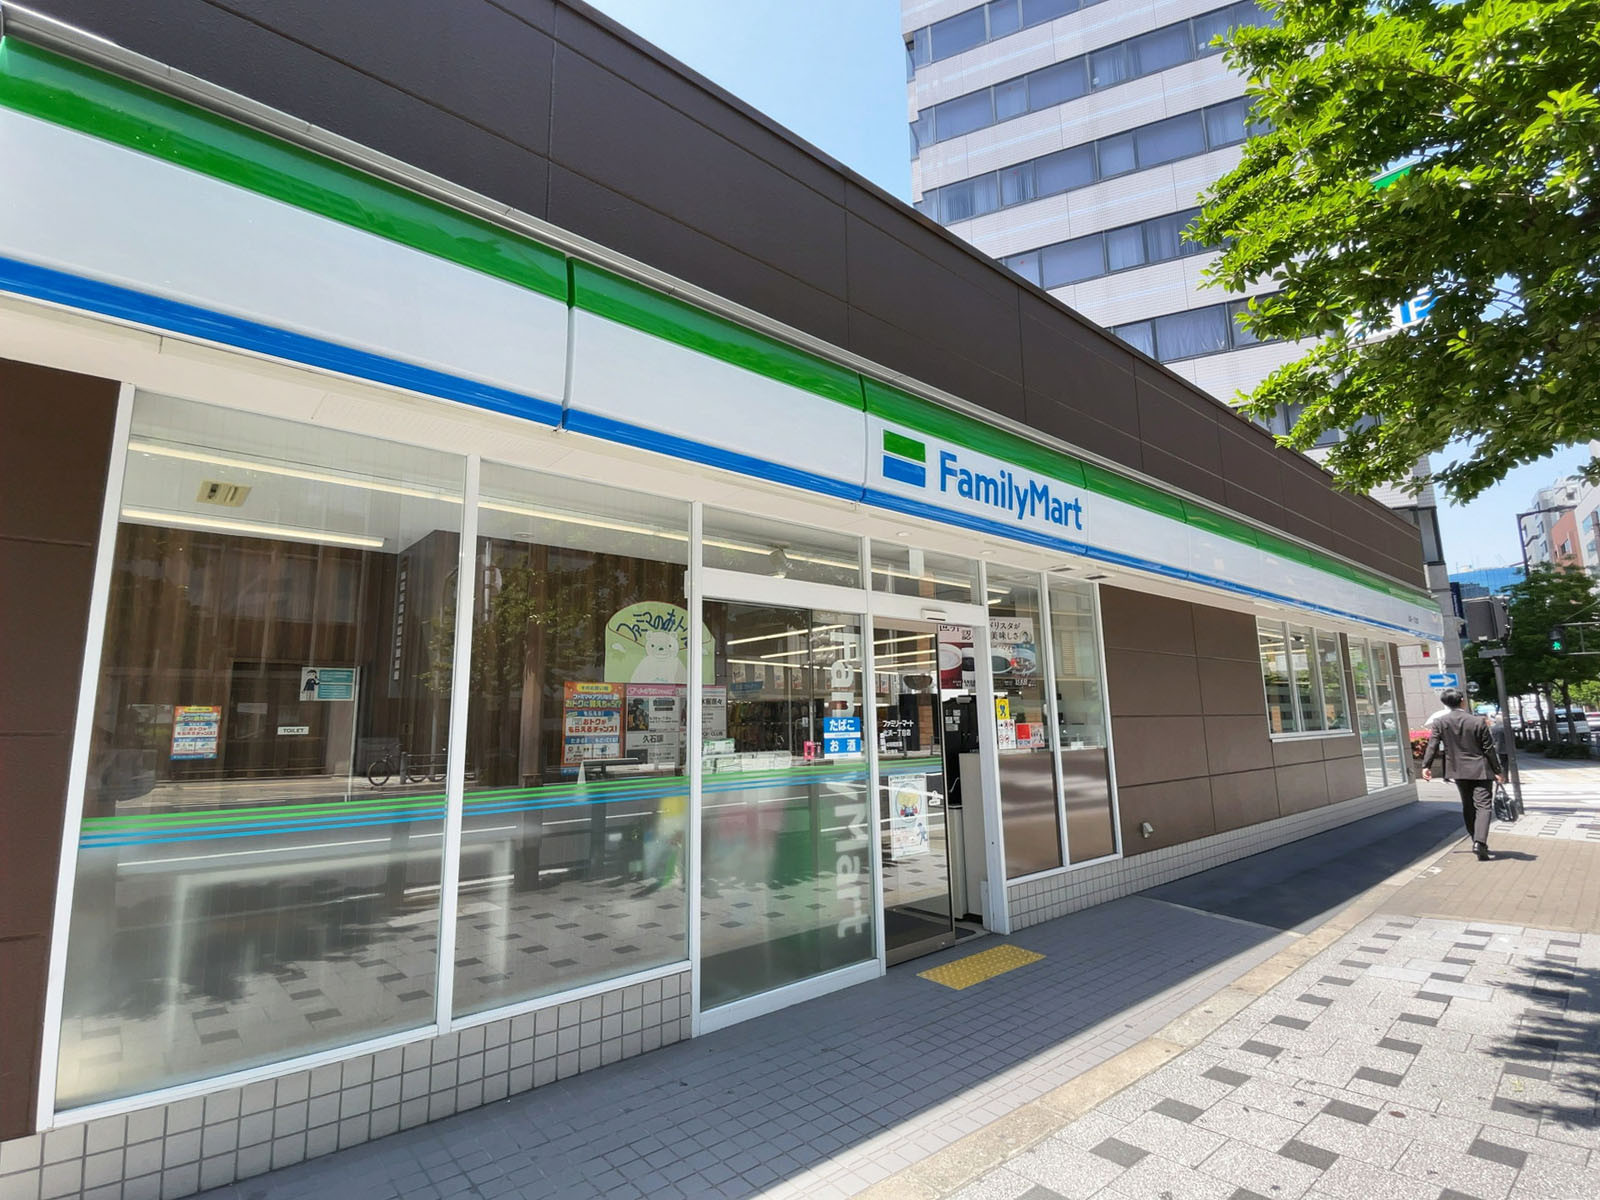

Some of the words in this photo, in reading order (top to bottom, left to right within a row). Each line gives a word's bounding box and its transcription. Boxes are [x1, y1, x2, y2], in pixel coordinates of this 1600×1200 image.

[939, 450, 1082, 531] FamilyMart
[568, 725, 617, 733] もらえるチャンス!
[829, 719, 855, 731] たばこ
[882, 719, 914, 728] ファミリーマート
[830, 739, 856, 752] お酒
